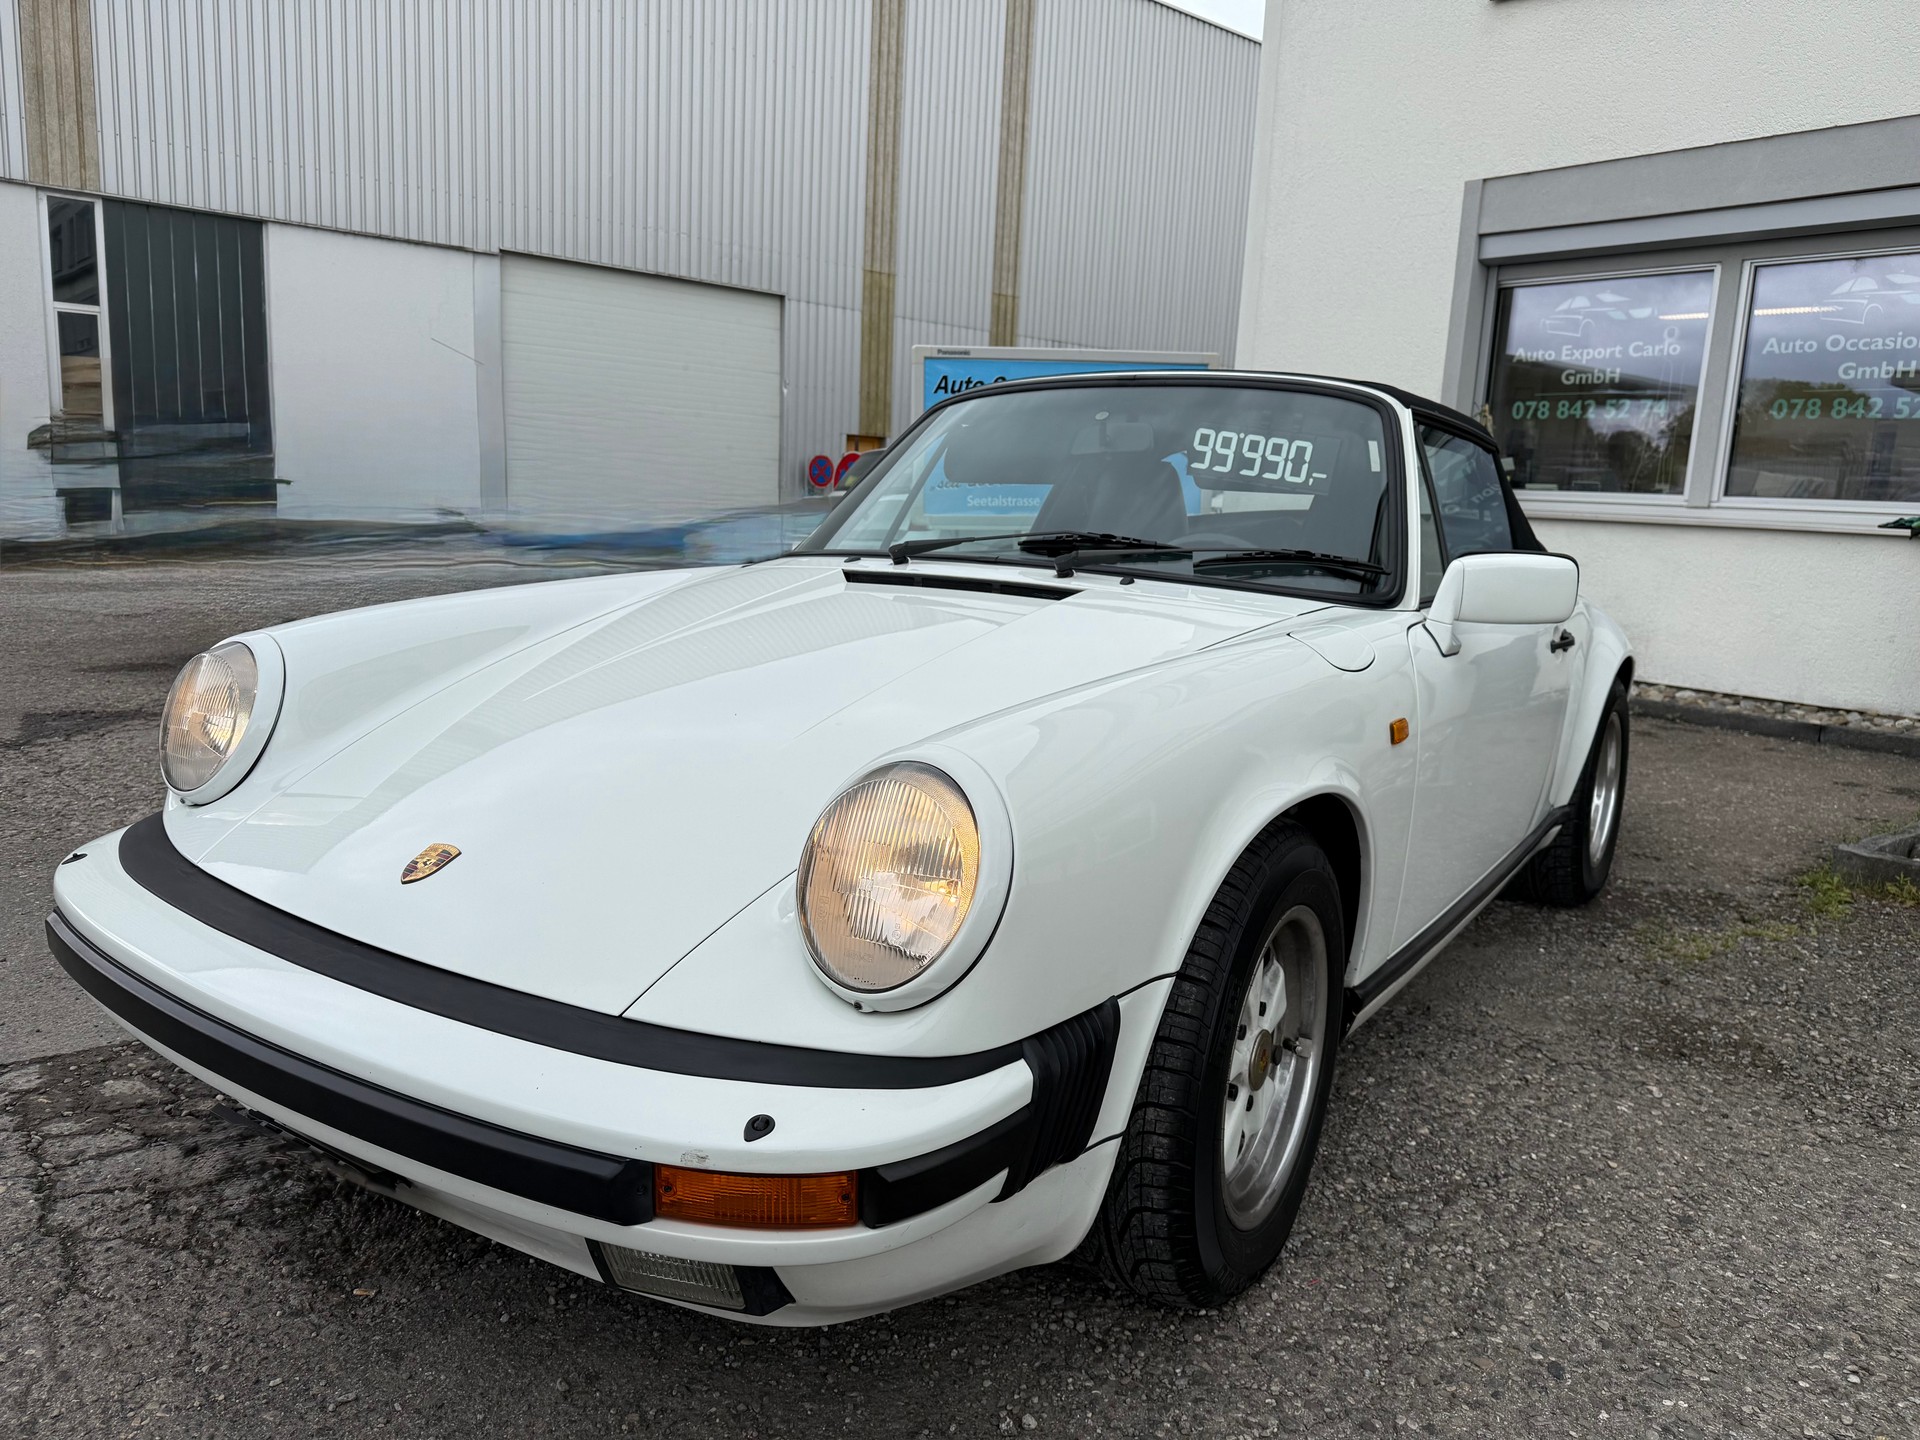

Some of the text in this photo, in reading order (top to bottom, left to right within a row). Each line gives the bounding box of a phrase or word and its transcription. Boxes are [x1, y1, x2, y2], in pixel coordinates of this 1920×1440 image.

[1513, 339, 1681, 364] Auto Export Carlo
[1762, 332, 1920, 354] Auto Occasio
[1561, 368, 1621, 385] GmbH
[1837, 360, 1917, 380] GmbH
[1512, 397, 1669, 420] 078 842 52 74
[1771, 398, 1822, 420] 078
[1830, 397, 1884, 420] 842
[966, 494, 1041, 507] Seetalstrasse
